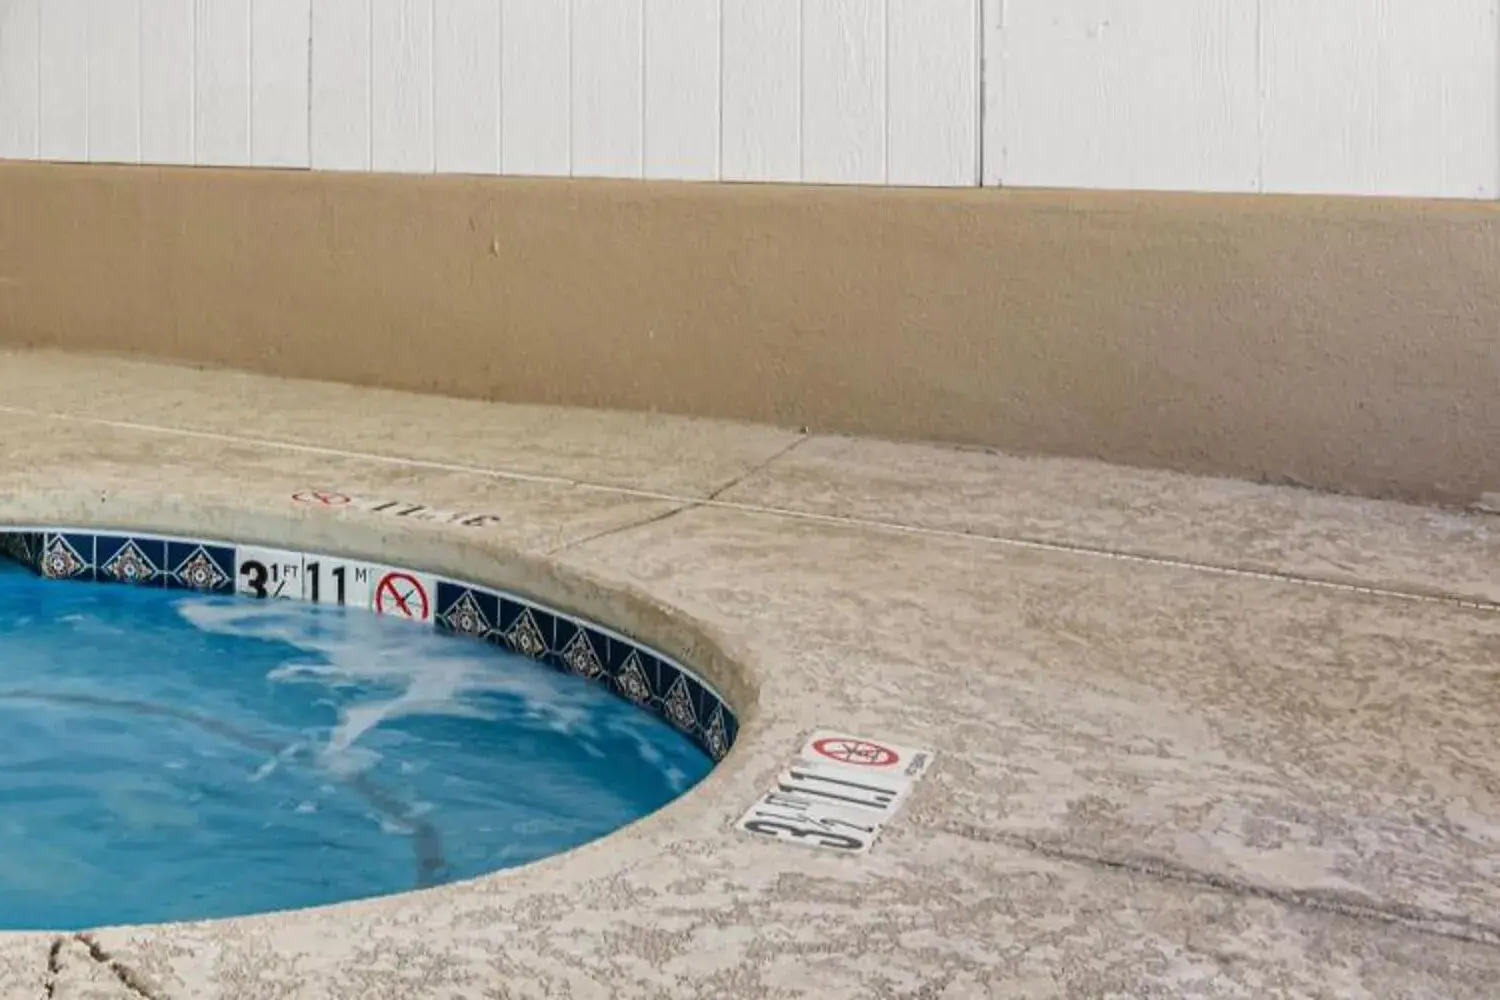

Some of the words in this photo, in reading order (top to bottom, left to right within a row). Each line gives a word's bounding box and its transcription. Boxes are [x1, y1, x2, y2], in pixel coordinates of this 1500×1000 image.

[283, 564, 299, 578] FT
[355, 567, 368, 583] M
[778, 770, 898, 809] 1.1
